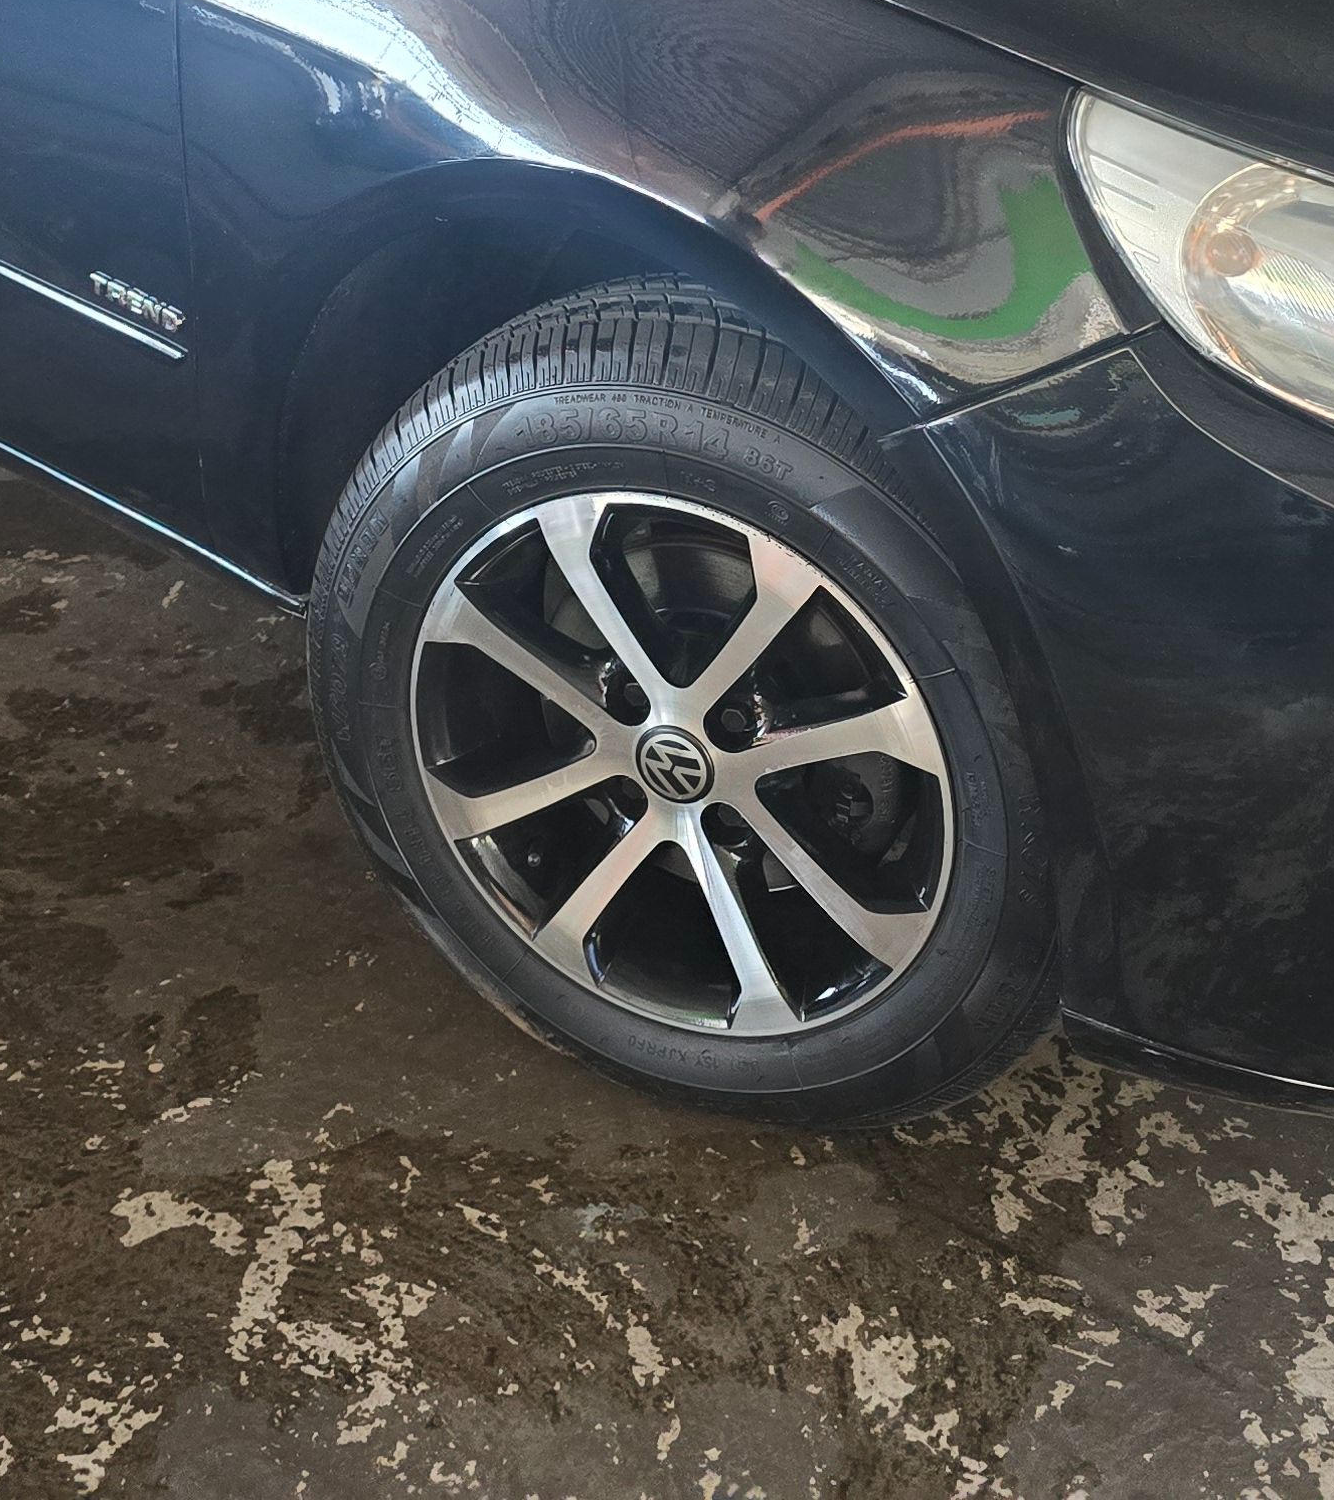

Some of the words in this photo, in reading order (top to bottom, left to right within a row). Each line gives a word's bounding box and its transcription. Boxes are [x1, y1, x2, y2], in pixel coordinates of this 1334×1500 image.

[90, 271, 186, 332] TREND
[516, 407, 729, 460] 185/65R14
[553, 393, 606, 406] TREADWEAR
[634, 394, 681, 411] TRACTION
[701, 407, 768, 439] TEMPERATURE
